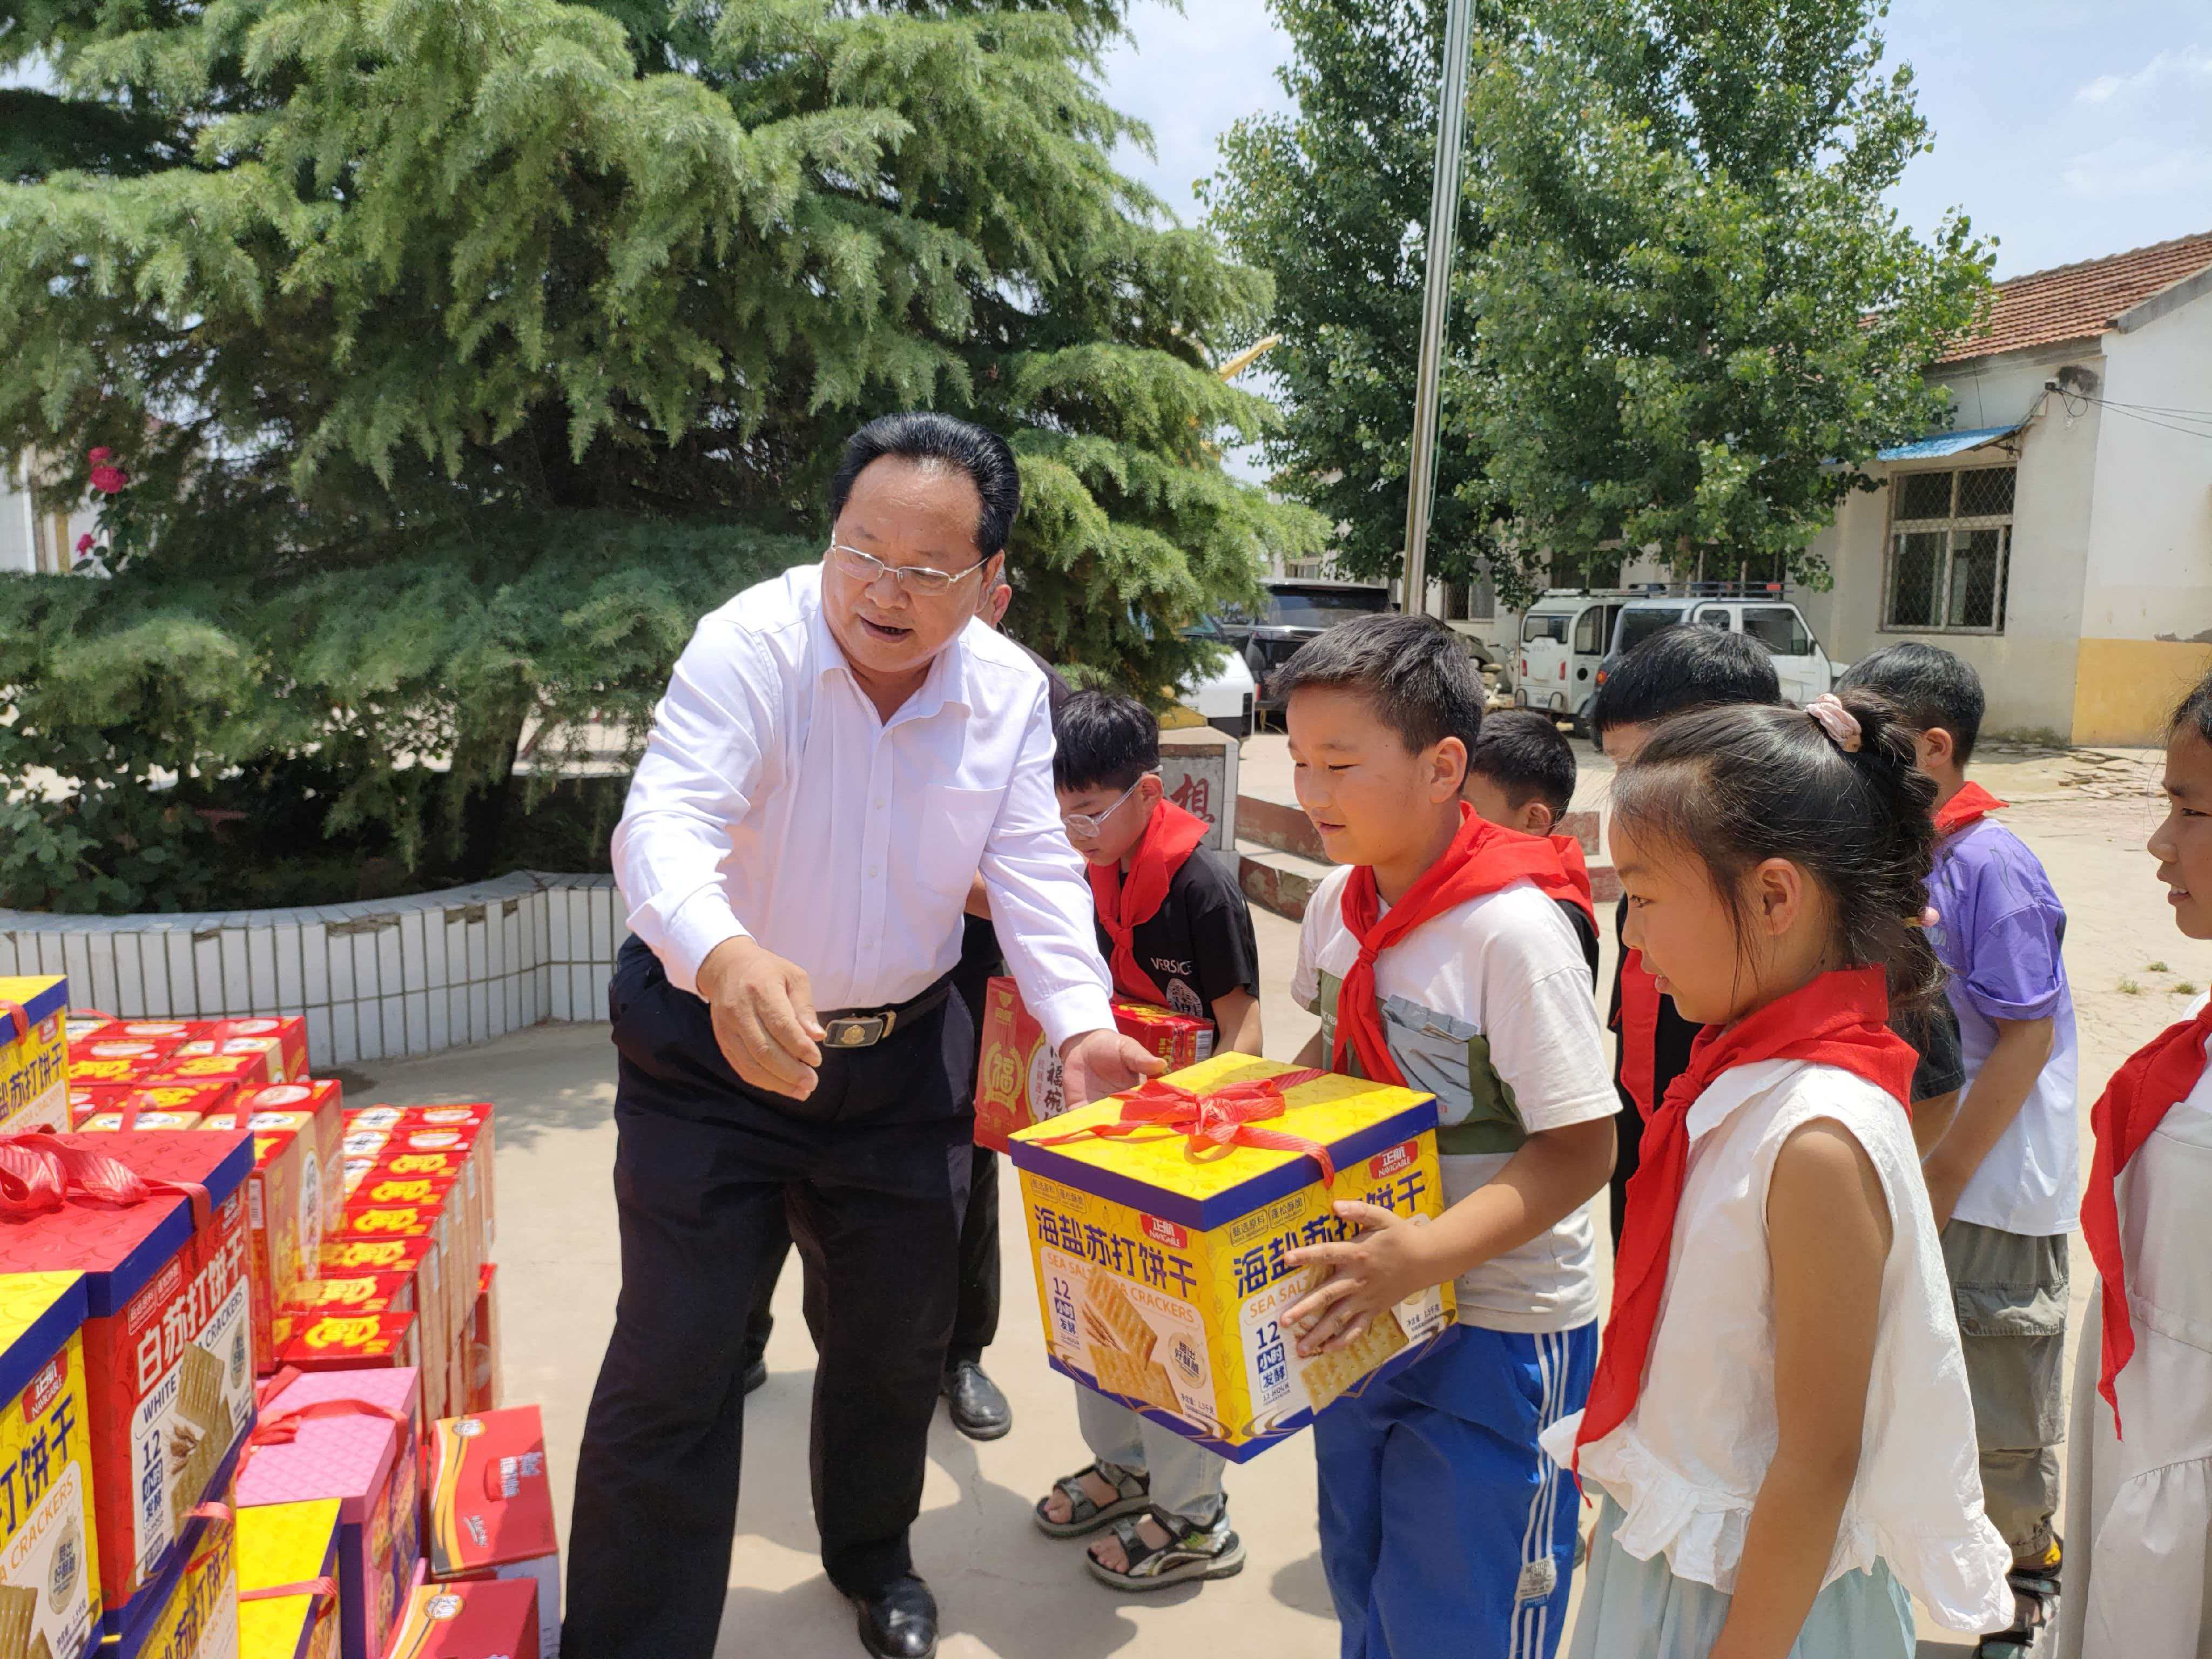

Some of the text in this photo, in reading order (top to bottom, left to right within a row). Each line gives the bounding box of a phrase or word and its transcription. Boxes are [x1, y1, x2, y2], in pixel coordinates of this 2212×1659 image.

[1043, 1046, 1063, 1121] 福碗
[1034, 1204, 1197, 1298] 海盐苏打饼干
[137, 1226, 244, 1397] 白苏打饼干
[1047, 1251, 1066, 1269] SEA
[1130, 1286, 1194, 1324] CRACKERS
[1053, 1277, 1071, 1300] 12
[1249, 1297, 1276, 1318] SEA
[143, 1290, 243, 1424] WHITE CRACKERS
[1256, 1320, 1280, 1349] 12
[1259, 1346, 1284, 1370] 小时
[1263, 1365, 1285, 1388] 发酵
[143, 1429, 161, 1472] 12
[10, 1473, 74, 1570] CRACKERS
